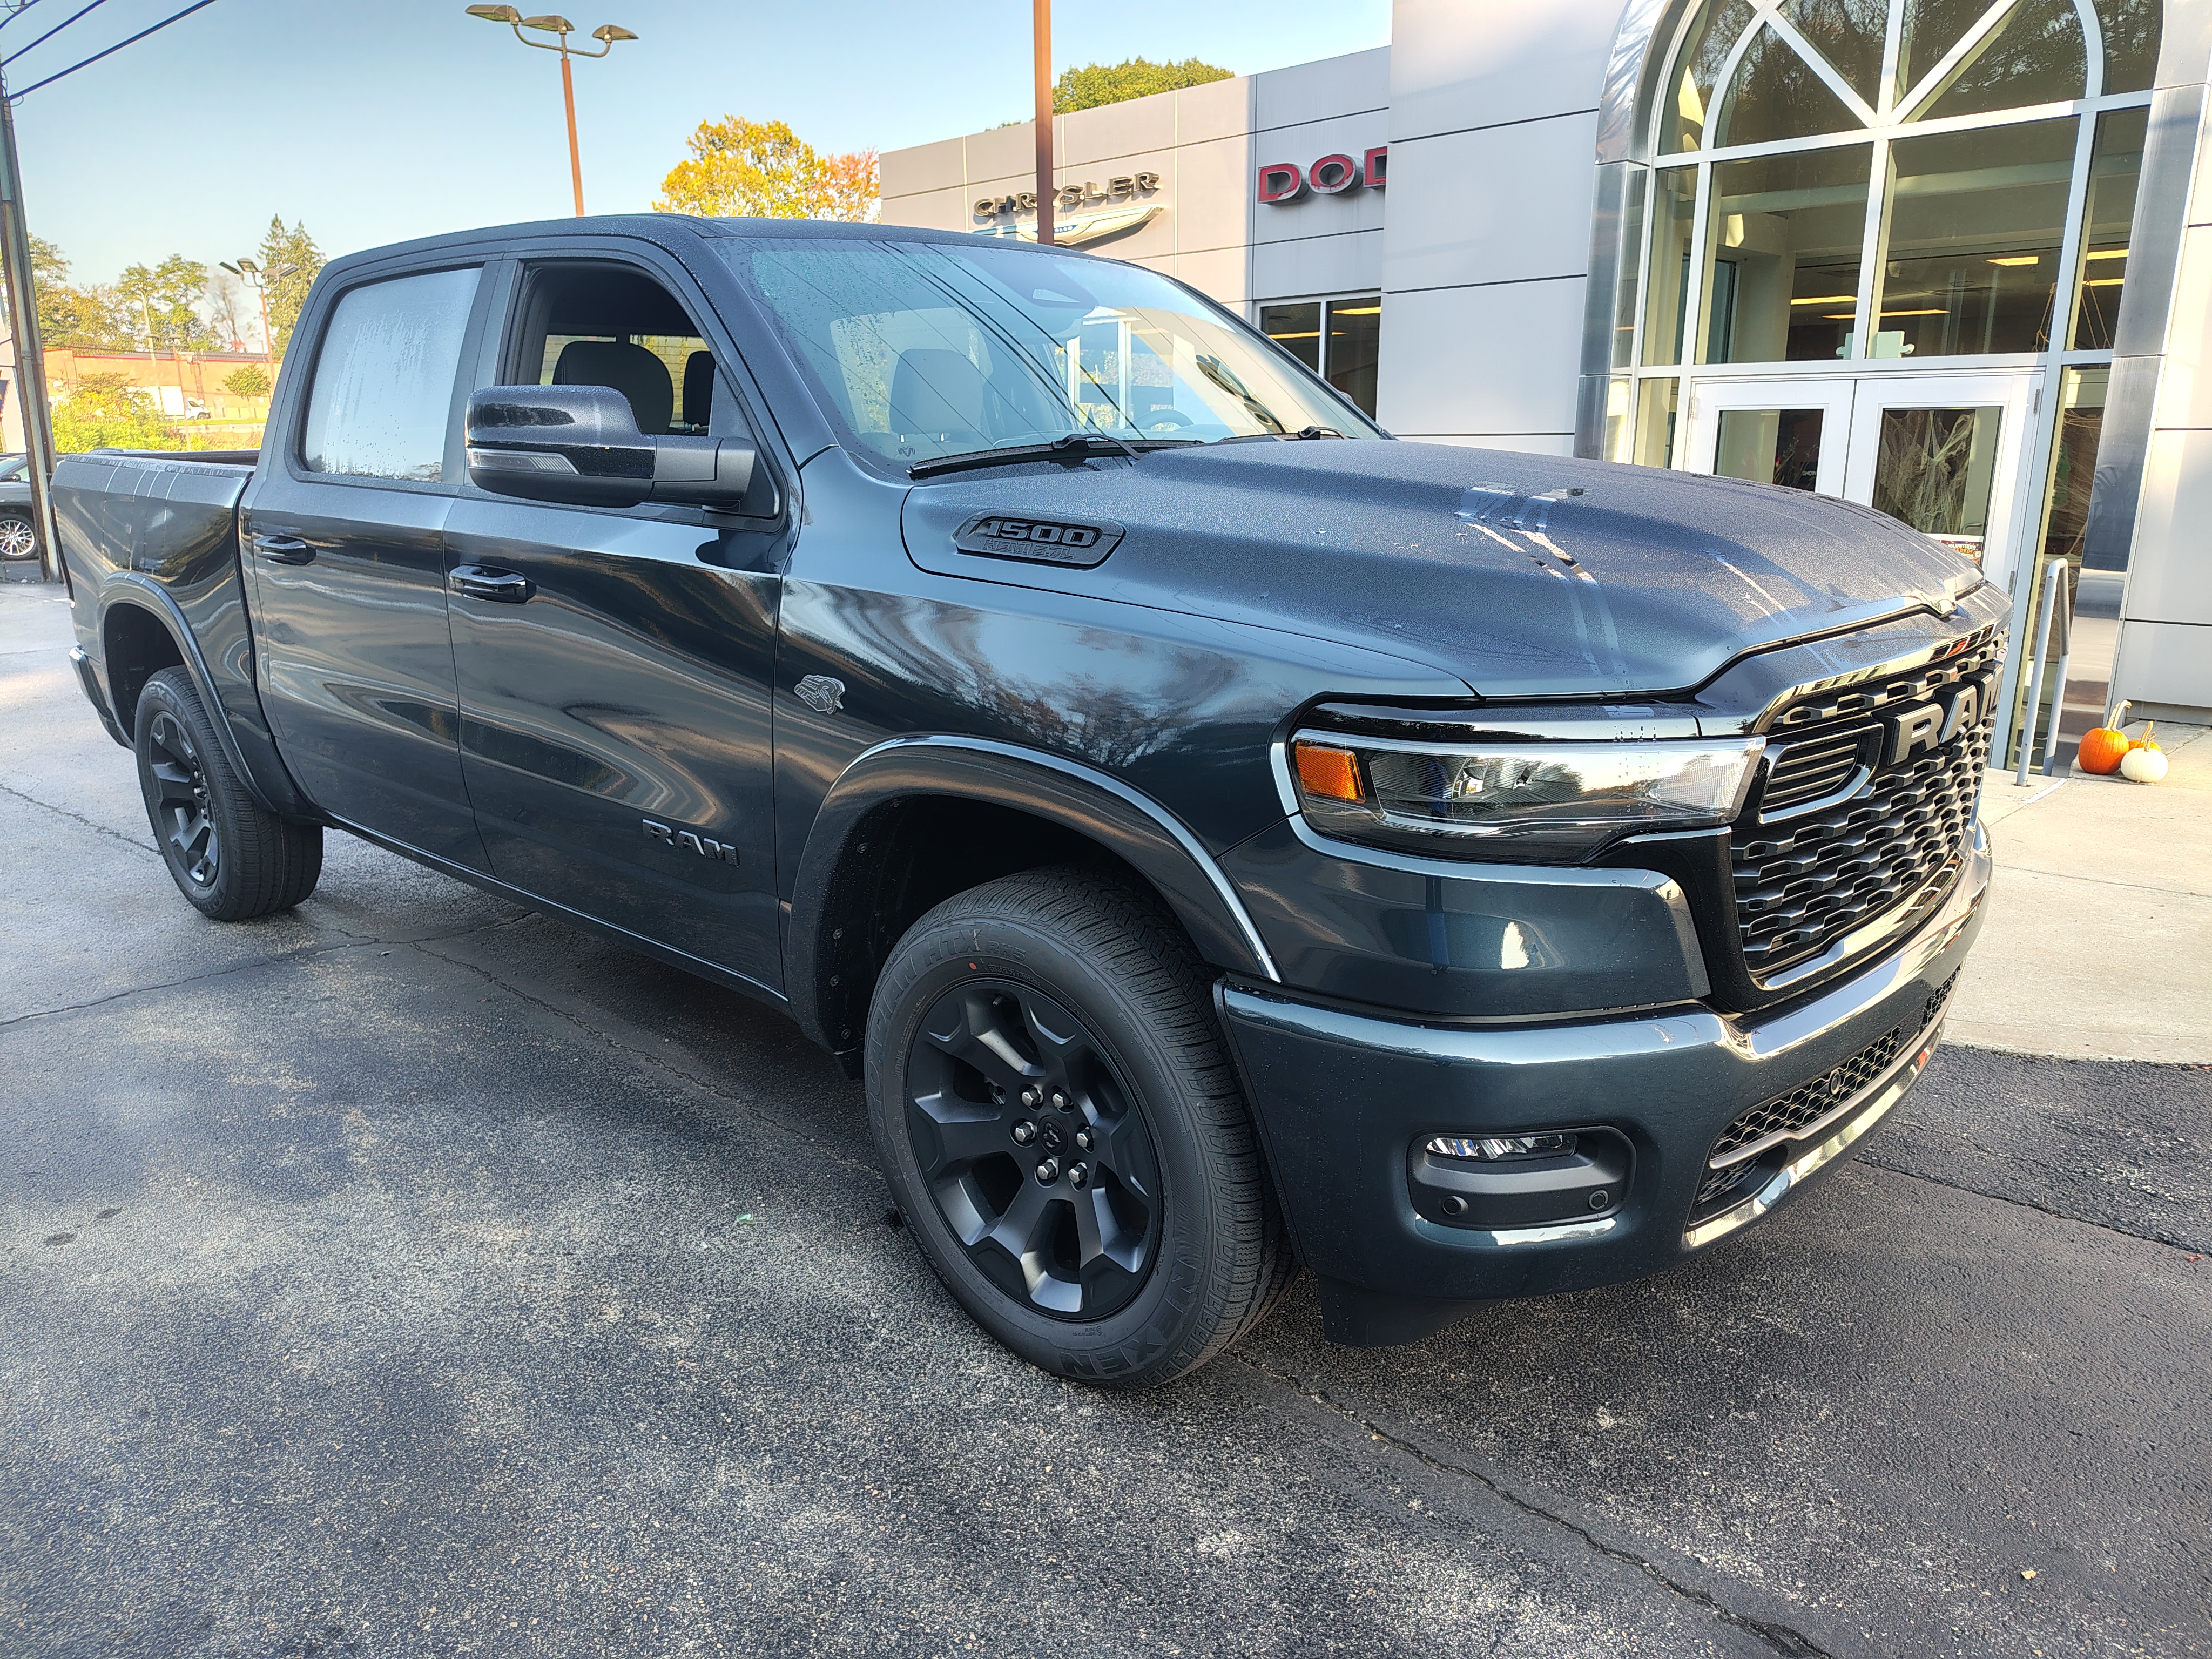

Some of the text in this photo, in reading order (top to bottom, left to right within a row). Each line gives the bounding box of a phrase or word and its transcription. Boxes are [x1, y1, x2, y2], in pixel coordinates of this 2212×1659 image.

[973, 172, 1160, 217] CHRSLER
[982, 538, 1074, 560] HEMI 5.7L
[987, 520, 1097, 547] 1500
[1888, 665, 2005, 767] RAM
[642, 818, 740, 868] RAM
[1060, 1257, 1198, 1375] NEXEN
